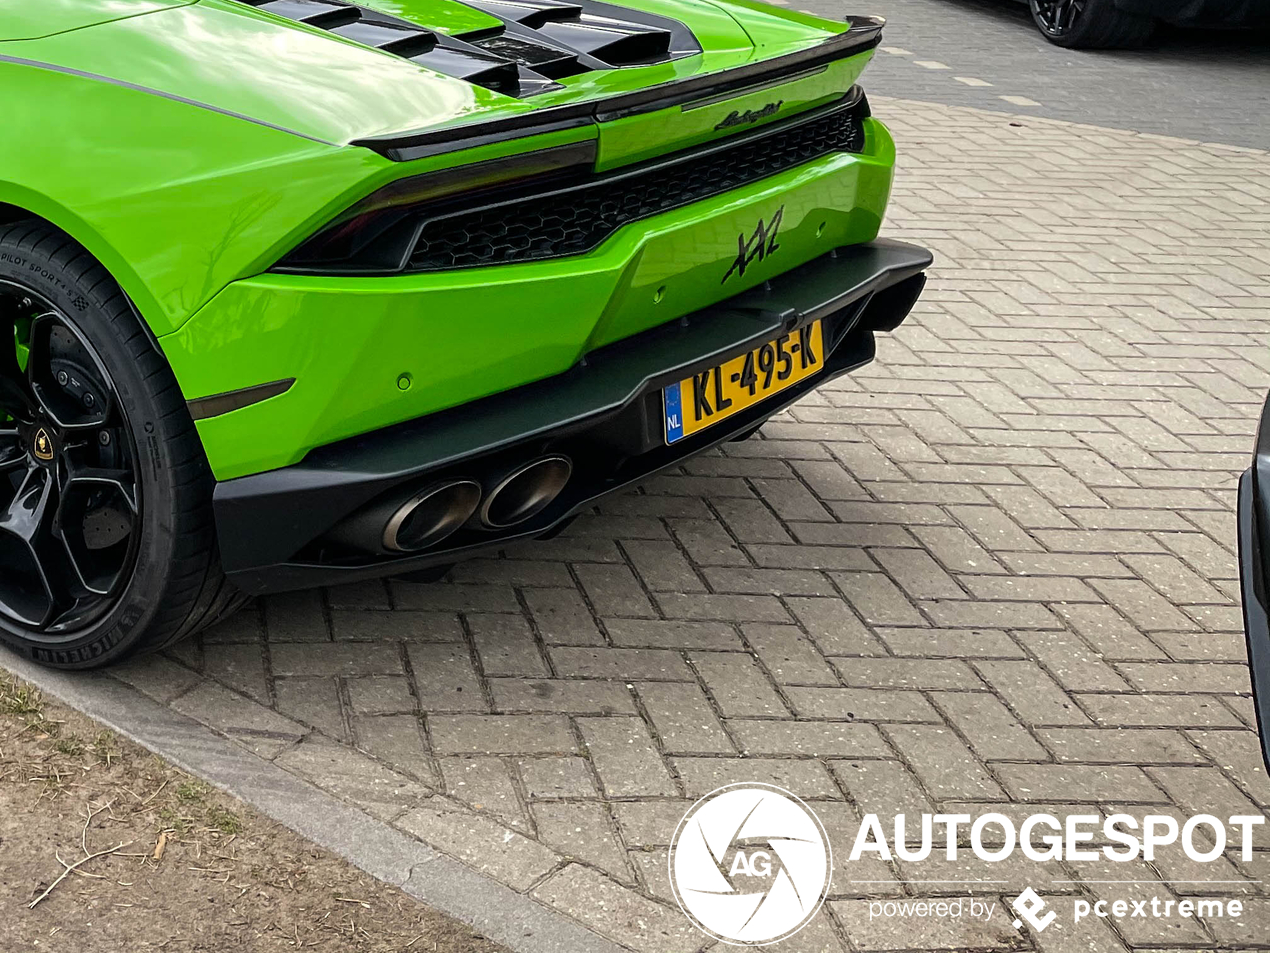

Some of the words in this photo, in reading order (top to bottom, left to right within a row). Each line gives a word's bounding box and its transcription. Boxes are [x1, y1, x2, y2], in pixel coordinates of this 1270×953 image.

[0, 252, 28, 267] PILOT
[29, 263, 61, 286] SPORT
[667, 414, 680, 432] NL
[693, 323, 816, 421] KL-495-K
[27, 626, 124, 664] MICHELIN
